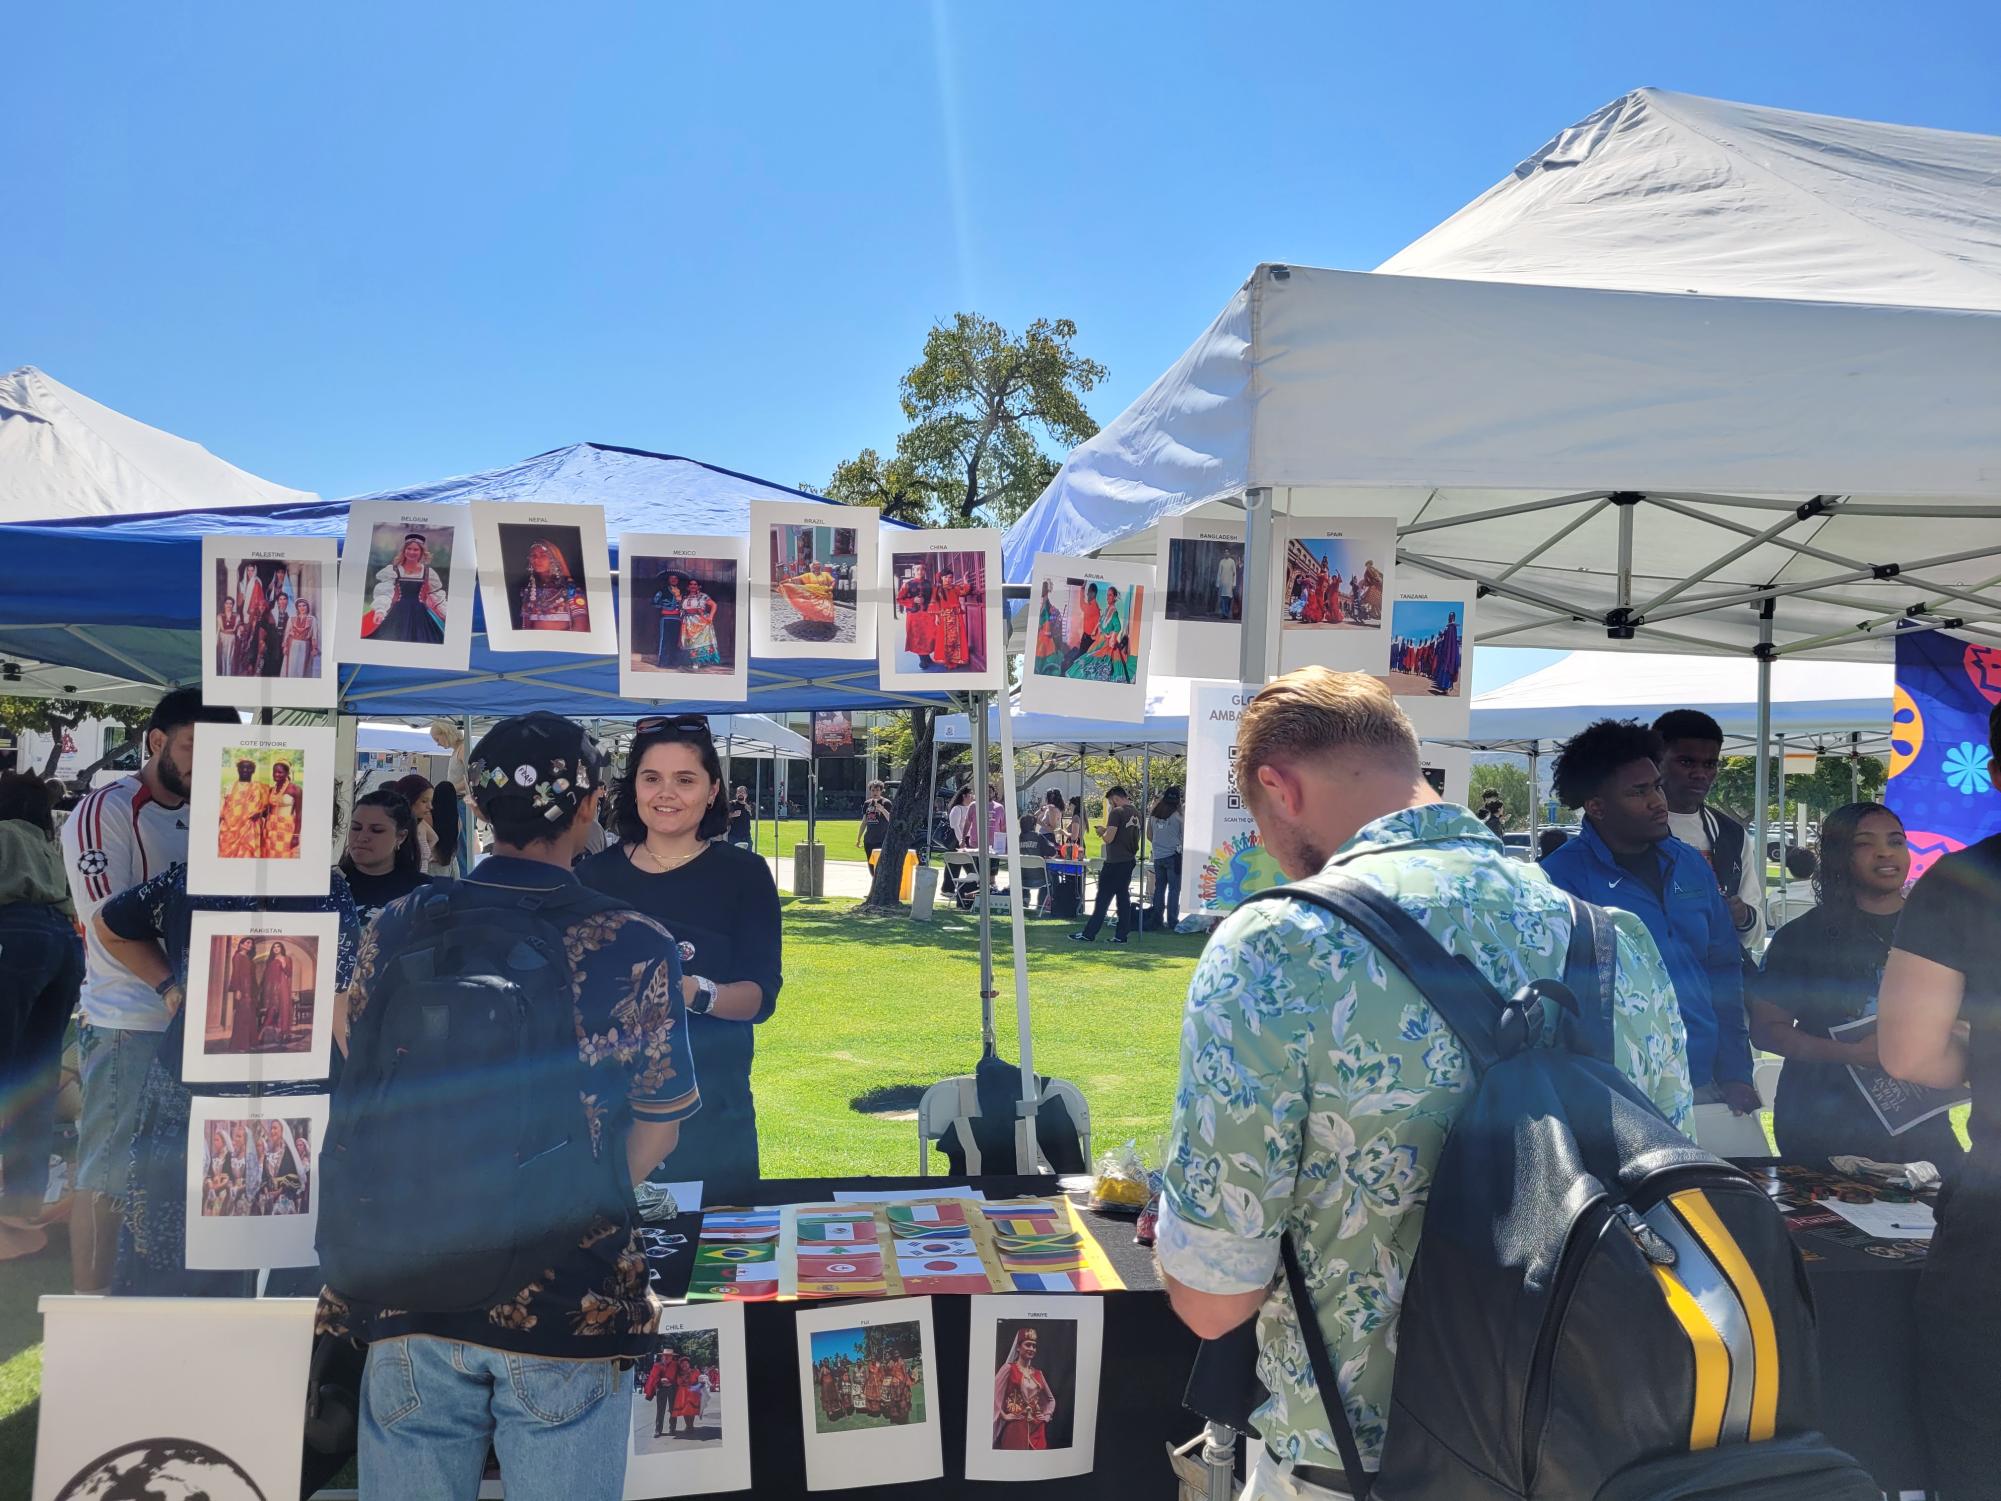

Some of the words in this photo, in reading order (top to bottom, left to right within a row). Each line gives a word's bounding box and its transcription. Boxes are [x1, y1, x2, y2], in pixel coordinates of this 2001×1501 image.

[401, 515, 429, 523] BELGIUM
[1200, 533, 1238, 541] BANGLADESH
[1084, 572, 1104, 580] ARUBA
[1231, 695, 1255, 706] GLO
[1209, 709, 1242, 722] AMBA
[665, 1323, 685, 1331] CHILE
